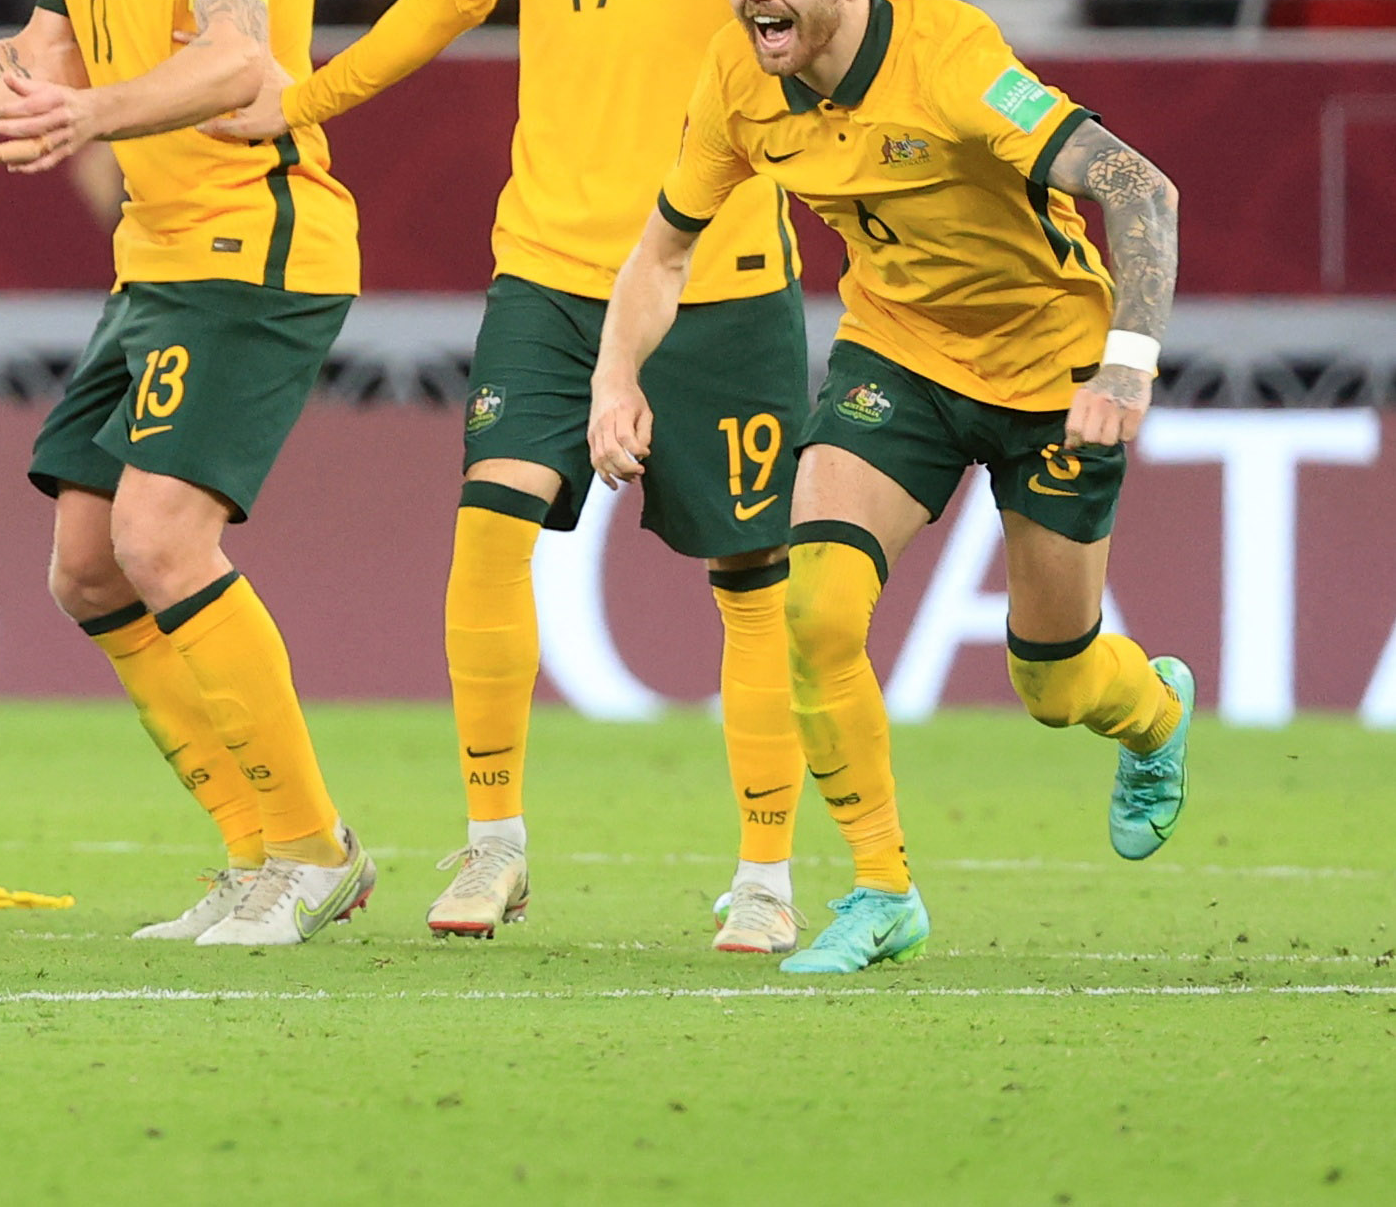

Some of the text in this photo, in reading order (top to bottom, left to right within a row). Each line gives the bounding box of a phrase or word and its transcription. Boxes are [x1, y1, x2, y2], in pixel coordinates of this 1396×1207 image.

[853, 199, 901, 245] 6
[135, 345, 189, 421] 13
[717, 412, 782, 496] 19
[468, 769, 510, 787] AUS
[747, 810, 788, 826] AUS
